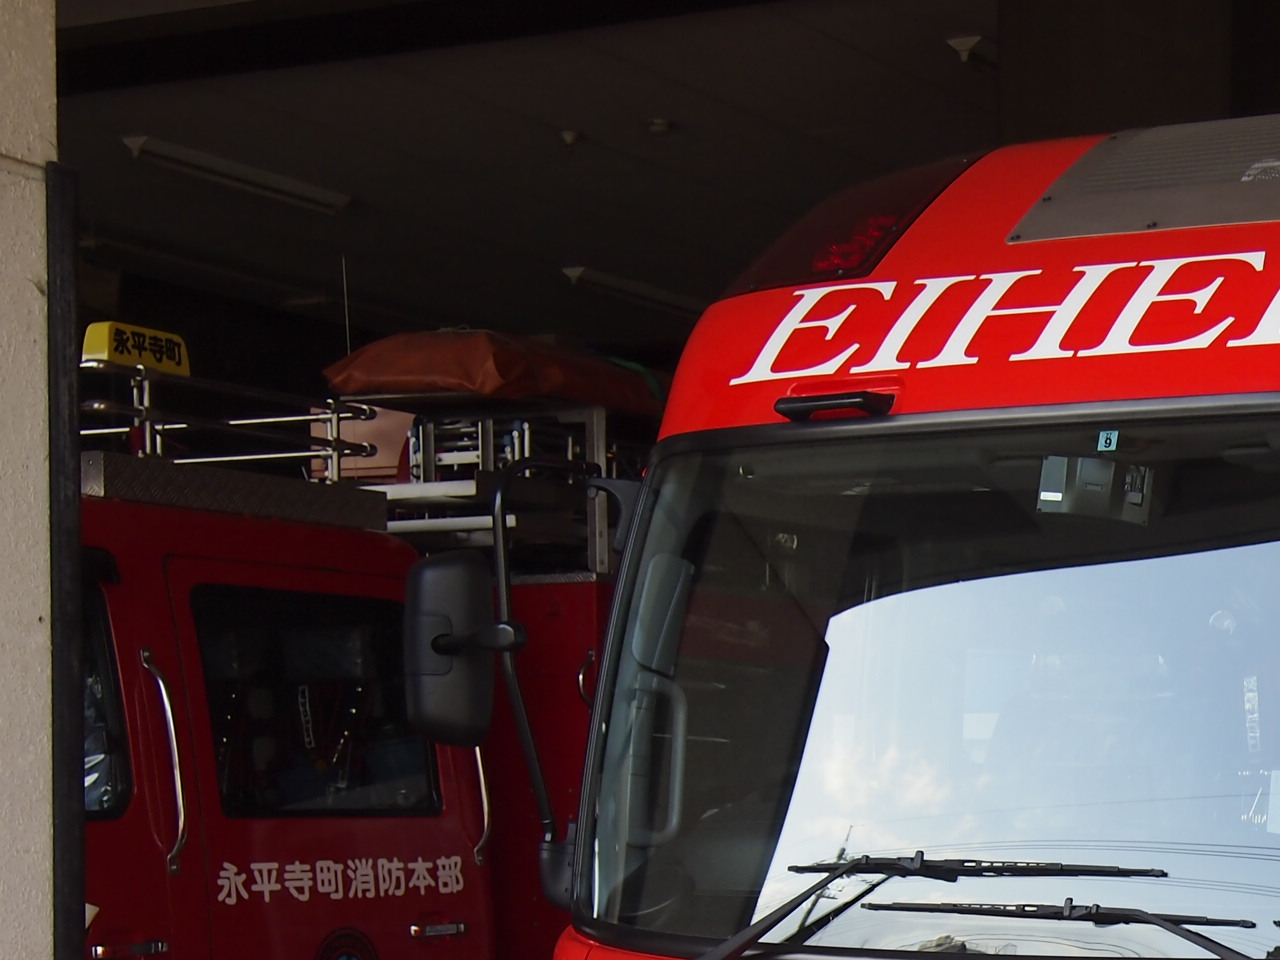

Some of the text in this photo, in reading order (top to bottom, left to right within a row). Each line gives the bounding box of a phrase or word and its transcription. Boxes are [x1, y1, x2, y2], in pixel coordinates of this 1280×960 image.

[113, 327, 182, 366] 永平寺町
[216, 855, 465, 906] 永平寺町消防本部
